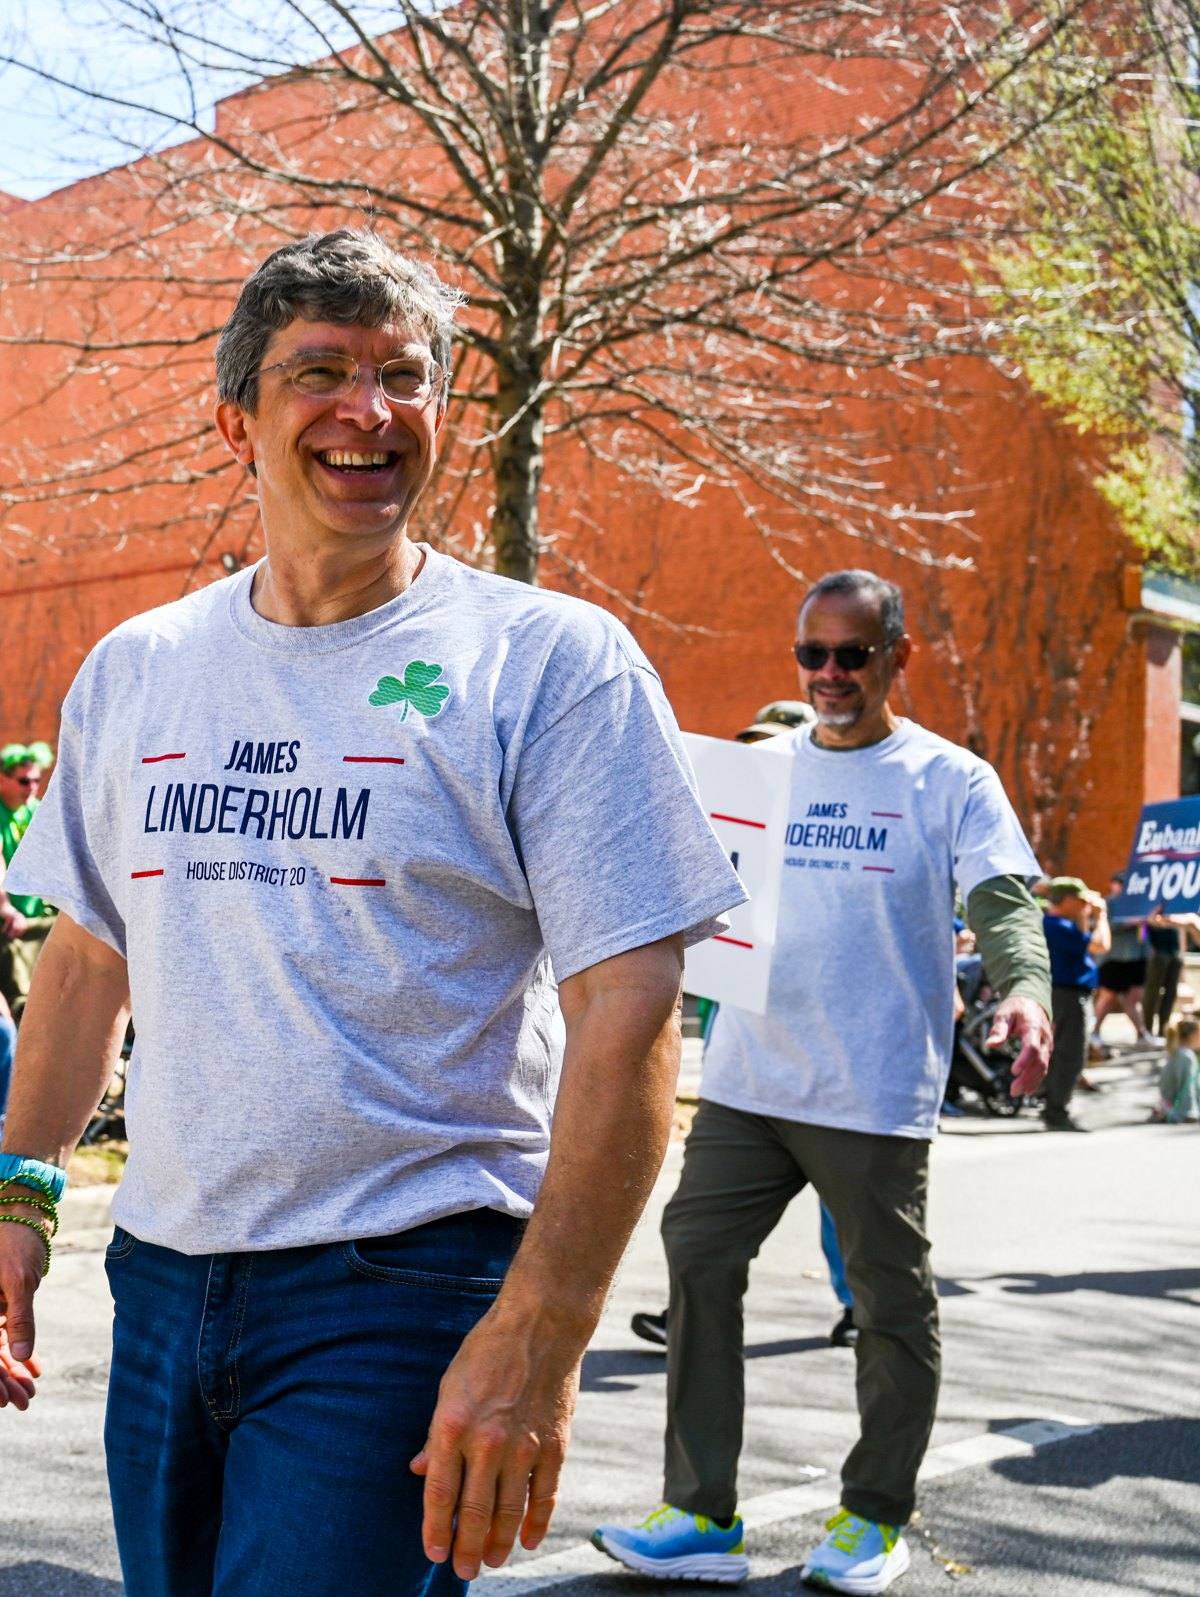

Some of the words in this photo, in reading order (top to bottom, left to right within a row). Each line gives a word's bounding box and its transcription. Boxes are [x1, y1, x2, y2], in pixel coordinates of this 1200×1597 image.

[224, 740, 301, 774] JAMES
[144, 783, 371, 840] LINDERHOLM
[806, 803, 849, 819] JAMES
[1136, 820, 1200, 853] Euban
[186, 861, 226, 881] HOUSE
[229, 861, 288, 886] DISTRICT
[289, 866, 306, 886] 20
[1147, 861, 1200, 901] YOU
